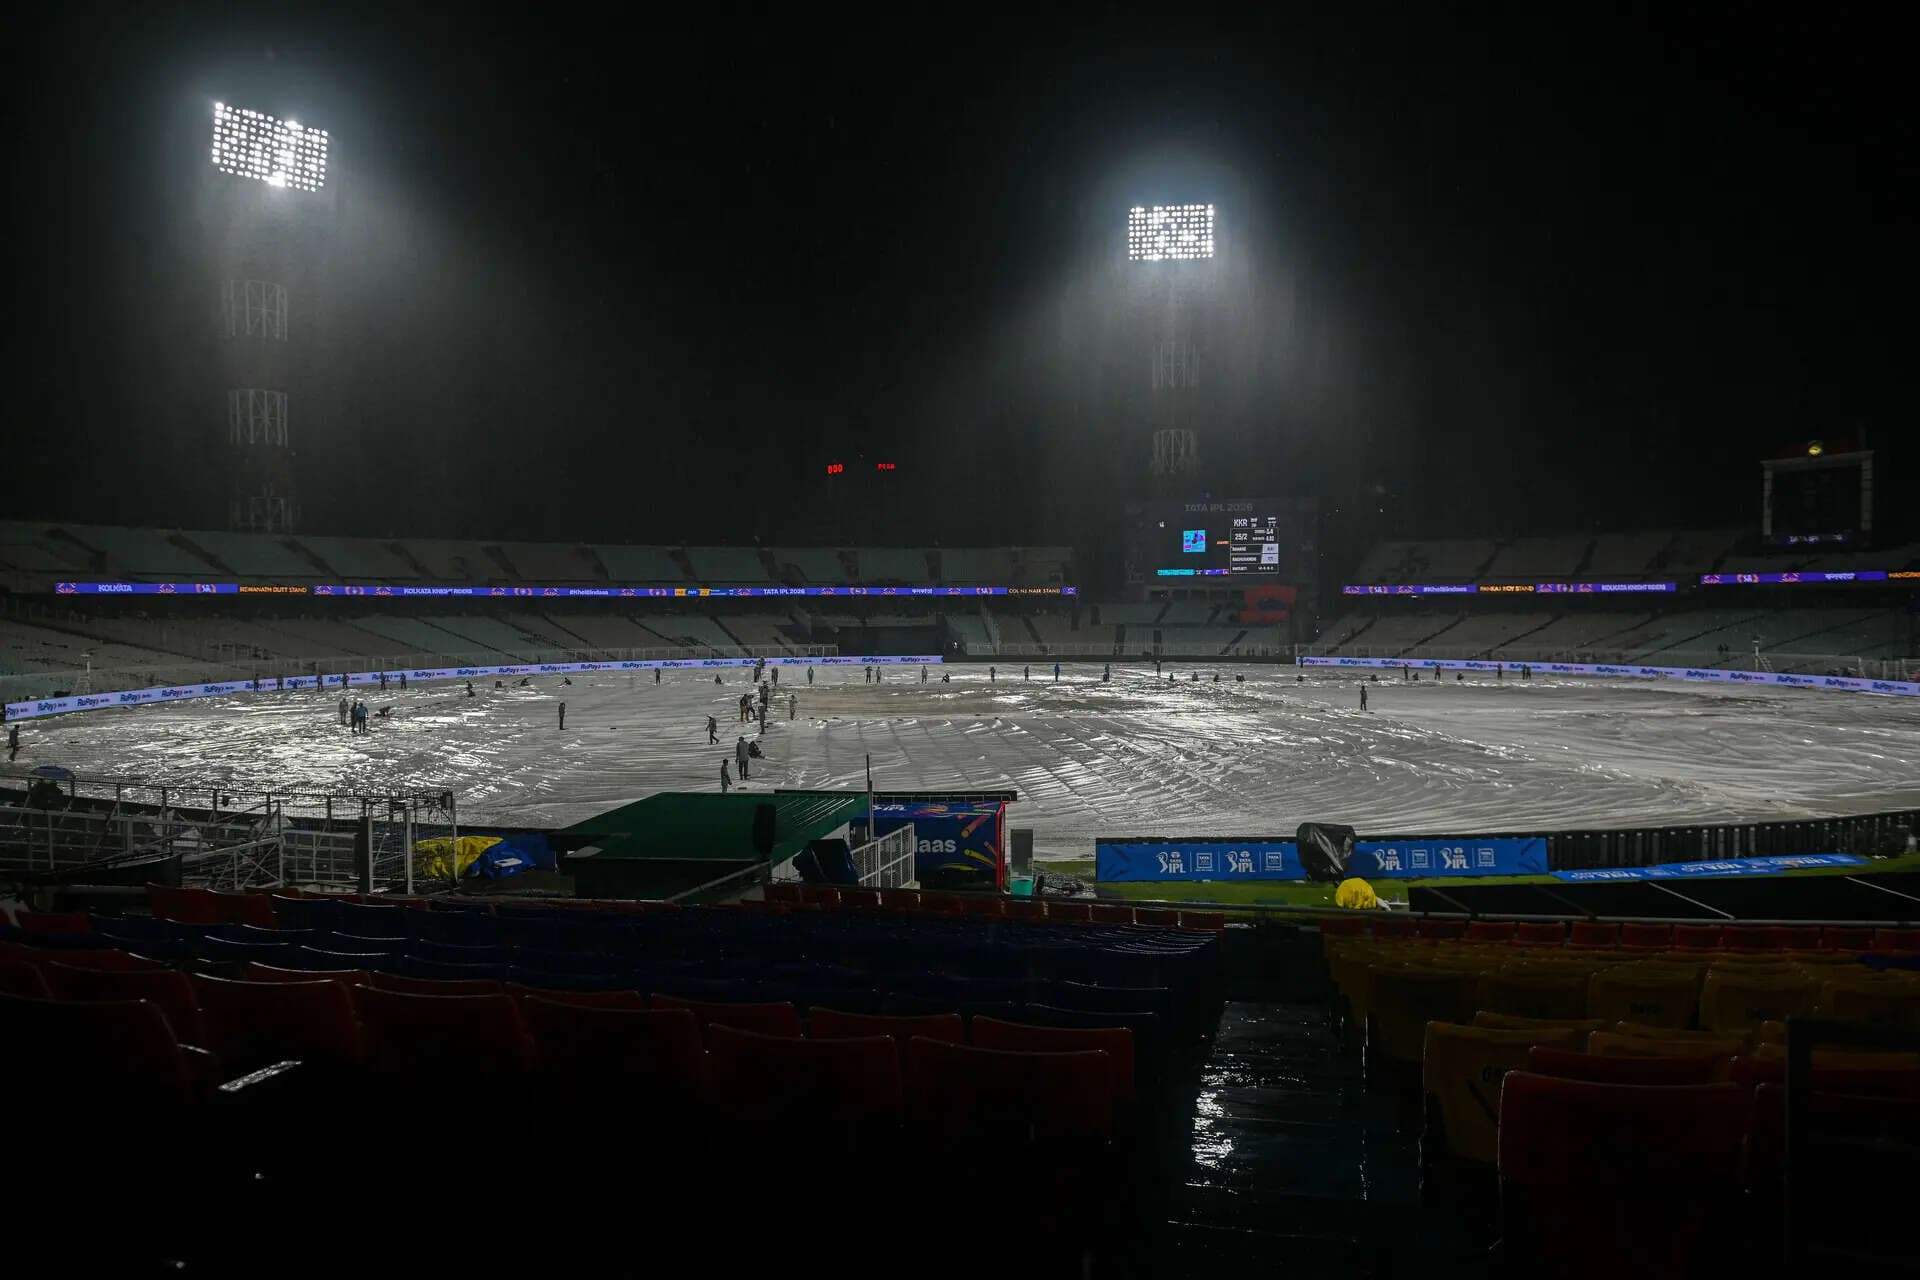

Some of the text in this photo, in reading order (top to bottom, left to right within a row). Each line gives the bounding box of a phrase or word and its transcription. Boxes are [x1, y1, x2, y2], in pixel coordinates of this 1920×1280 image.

[1184, 503, 1208, 512] TATA
[1209, 503, 1225, 512] IPL
[1233, 518, 1248, 527] KKR
[1234, 533, 1248, 541] 25/2
[98, 584, 132, 592] KOLKATA
[498, 667, 517, 675] RuPay
[580, 663, 599, 671] RuPay
[162, 689, 180, 698] RuPay
[203, 685, 222, 694] RuPay
[77, 698, 96, 707] RuPay
[120, 694, 138, 703] RuPay
[38, 702, 55, 712] RuPay
[1168, 863, 1187, 874] IPL
[1238, 863, 1256, 873] IPL
[1385, 860, 1403, 870] IPL
[1451, 859, 1470, 869] IPL
